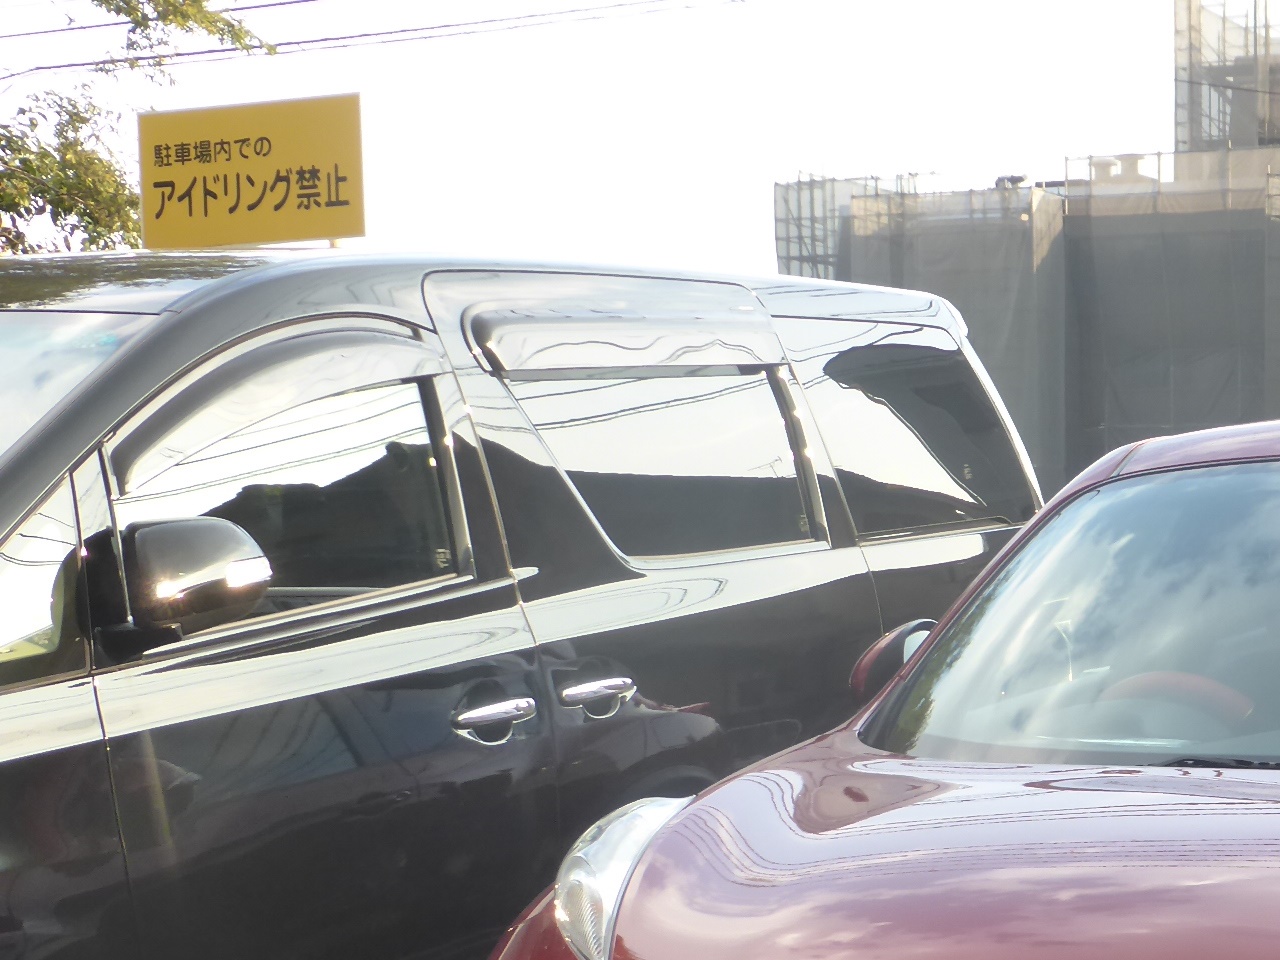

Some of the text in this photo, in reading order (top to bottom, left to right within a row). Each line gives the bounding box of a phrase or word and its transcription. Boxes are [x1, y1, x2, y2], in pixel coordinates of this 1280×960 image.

[153, 136, 272, 168] 駐車場内での
[152, 163, 350, 220] アイドリング禁止
